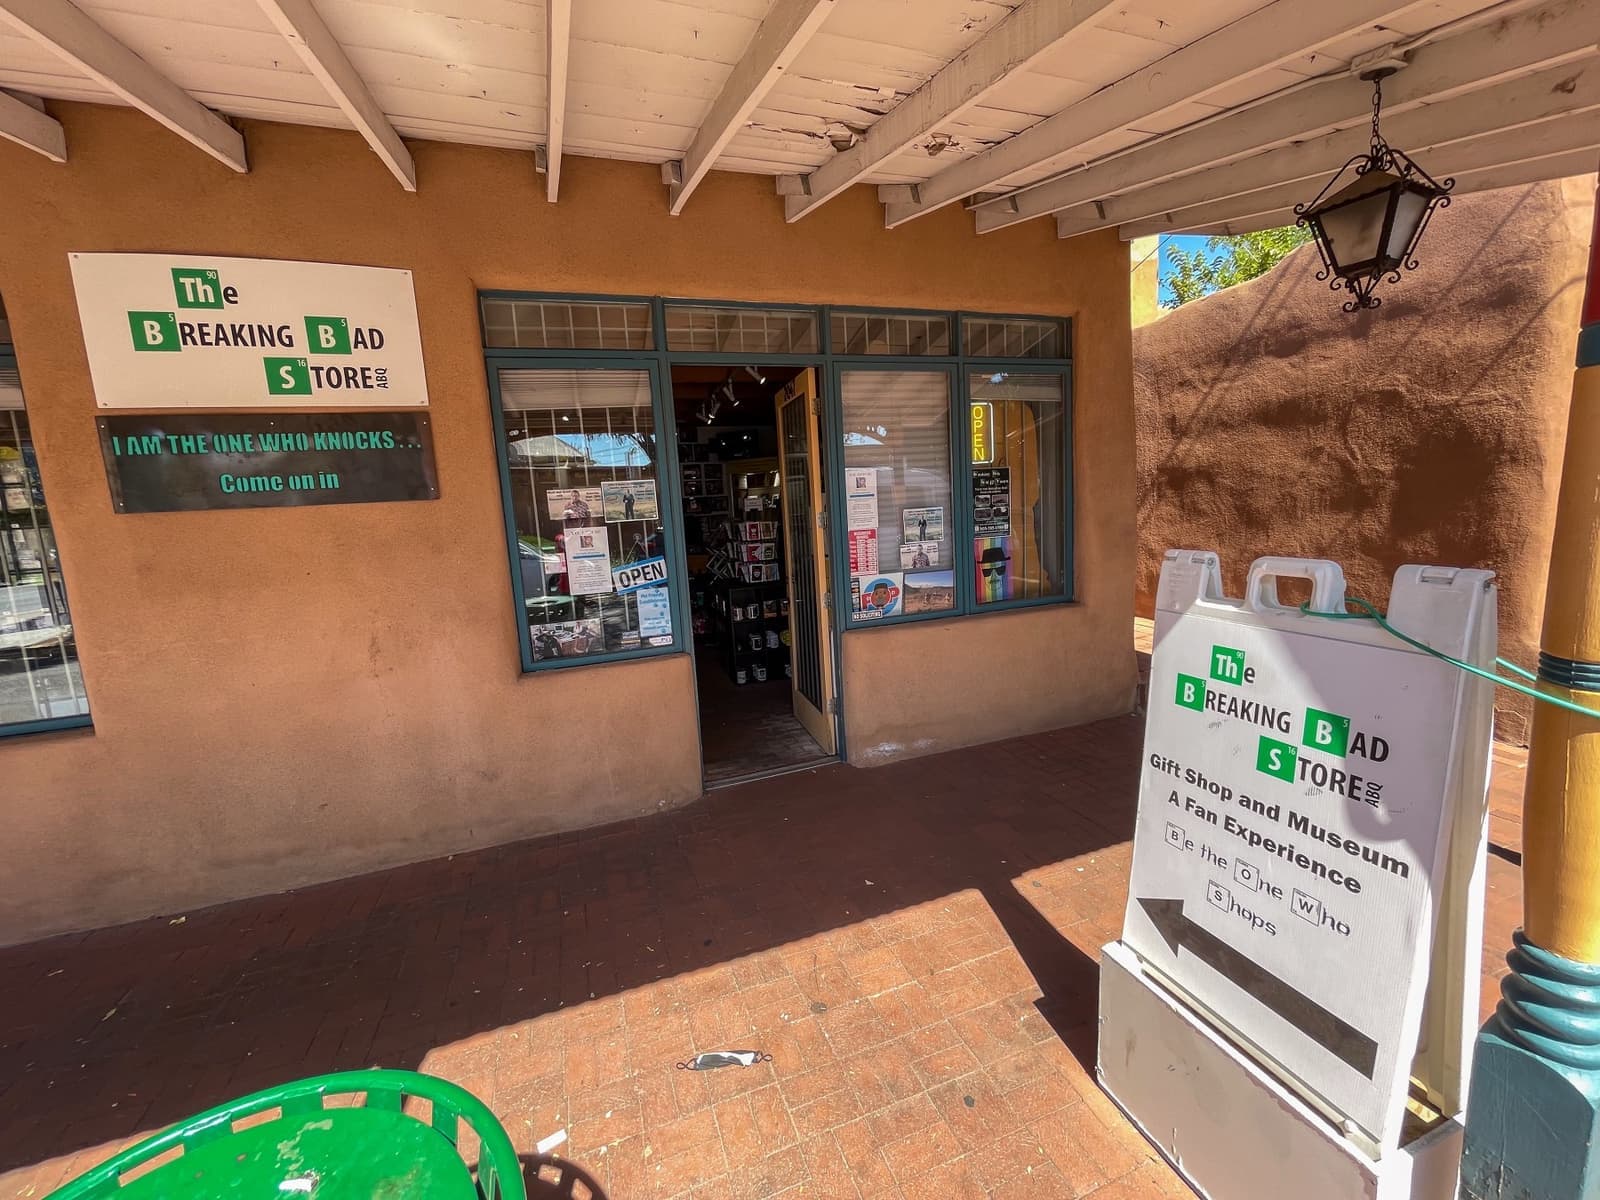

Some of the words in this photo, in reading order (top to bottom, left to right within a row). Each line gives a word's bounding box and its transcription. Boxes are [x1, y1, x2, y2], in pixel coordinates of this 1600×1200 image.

[206, 270, 217, 280] 90
[179, 276, 239, 305] The
[168, 313, 175, 323] 5
[341, 318, 346, 327] 5
[143, 320, 294, 348] BREAKING
[318, 324, 385, 350] BAD
[297, 359, 306, 367] 16
[279, 365, 374, 389] STORE
[376, 367, 389, 389] ABQ
[112, 436, 121, 456] I
[127, 435, 162, 456] AM
[167, 434, 209, 455] THE
[213, 433, 254, 454] ONE
[257, 432, 309, 452] WHO
[973, 406, 985, 461] OPEN
[219, 473, 284, 494] Come
[288, 474, 315, 492] on
[319, 471, 340, 490] in
[619, 562, 664, 588] OPEN
[1215, 653, 1255, 684] The
[1237, 651, 1244, 660] 90
[1184, 682, 1291, 734] BREAKING
[1343, 719, 1349, 728] 5
[1288, 746, 1296, 755] 16
[1315, 719, 1390, 763] BAD
[1268, 747, 1363, 802] STORE
[1365, 781, 1383, 808] ABQ
[1150, 753, 1181, 778] Gift
[1185, 768, 1233, 802] Shop
[1239, 790, 1280, 822] and
[1287, 811, 1410, 879] Museum
[1168, 790, 1179, 807] A
[1185, 798, 1218, 825] Fan
[1223, 814, 1362, 894] Experience
[1171, 829, 1194, 851] Be
[1201, 843, 1228, 870] the
[1241, 867, 1283, 901] One
[1299, 897, 1350, 937] Who
[1214, 888, 1277, 937] Shops
